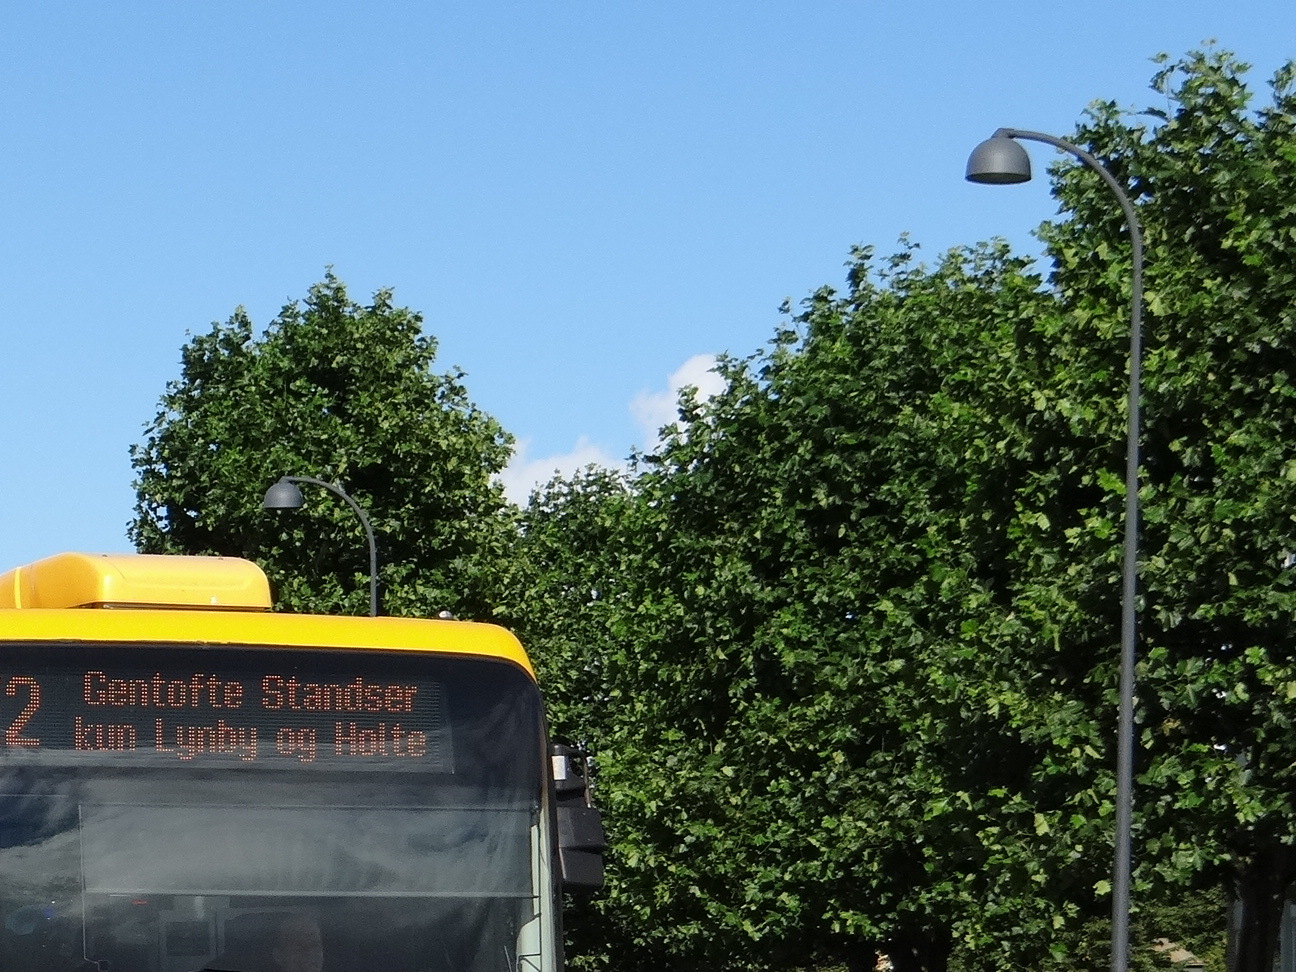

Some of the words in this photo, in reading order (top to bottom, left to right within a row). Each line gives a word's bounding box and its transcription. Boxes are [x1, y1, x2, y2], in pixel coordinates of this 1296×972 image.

[84, 671, 243, 708] Gentofte
[262, 675, 418, 712] Standser
[75, 716, 136, 751] kun
[155, 718, 257, 761] Lynby
[276, 728, 316, 763] og
[335, 721, 426, 757] Holte
